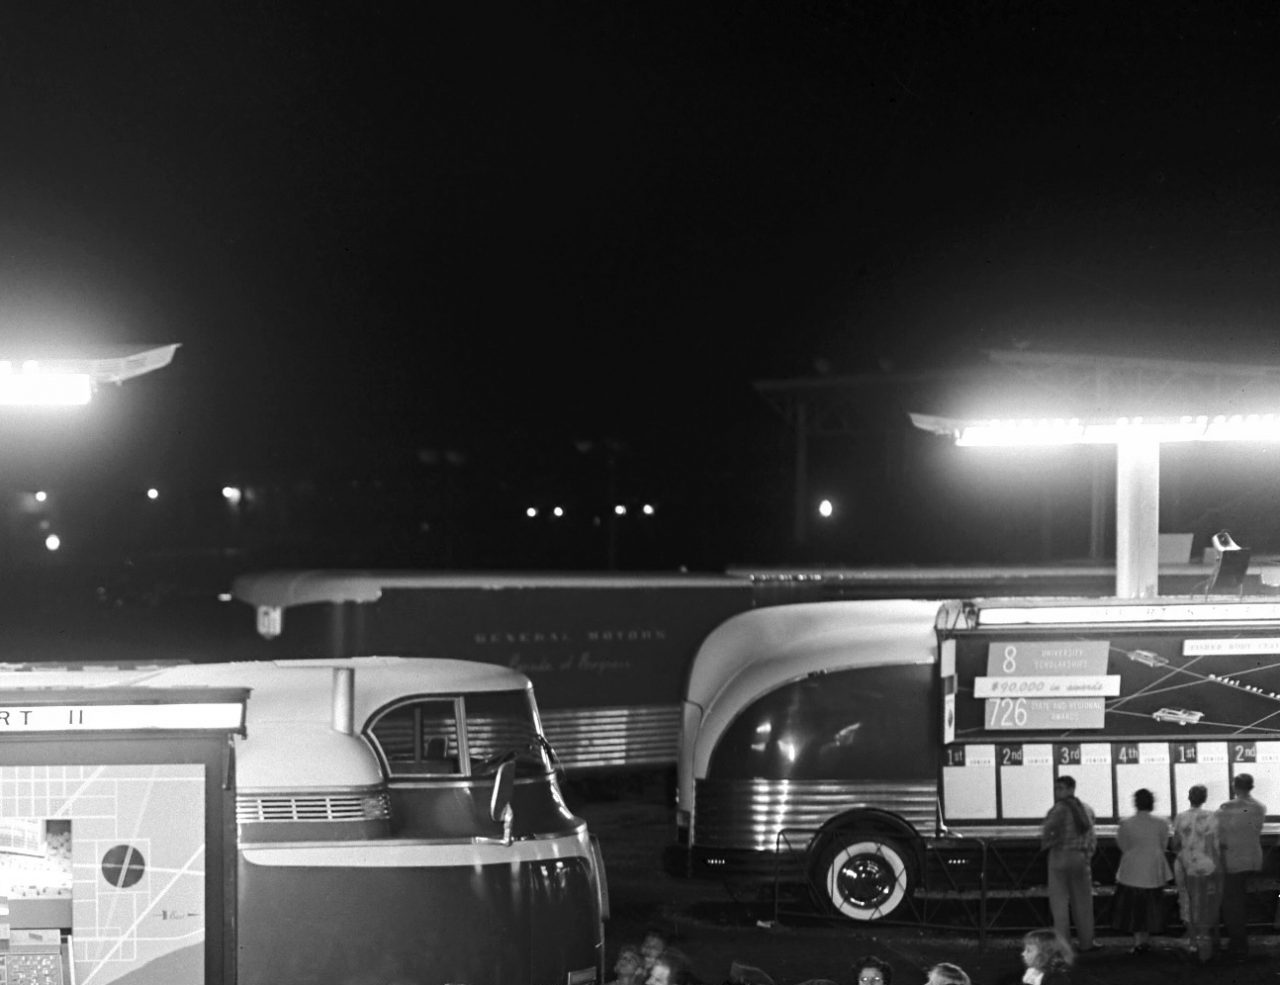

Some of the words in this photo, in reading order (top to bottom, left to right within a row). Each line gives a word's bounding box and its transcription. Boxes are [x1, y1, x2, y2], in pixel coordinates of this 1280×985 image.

[473, 632, 569, 644] GENERAL
[587, 630, 666, 641] MOTORS
[1002, 645, 1017, 673] 8
[1041, 647, 1084, 657] UNIVERSITY
[68, 709, 84, 725] II
[989, 698, 1028, 727] 726
[1053, 701, 1067, 711] AND
[947, 749, 964, 766] 1st
[1002, 747, 1023, 764] 2nd
[1060, 746, 1080, 764] 3rd
[1118, 745, 1139, 763] 4th
[1178, 745, 1196, 762] 1st
[1234, 744, 1257, 761] 2nd
